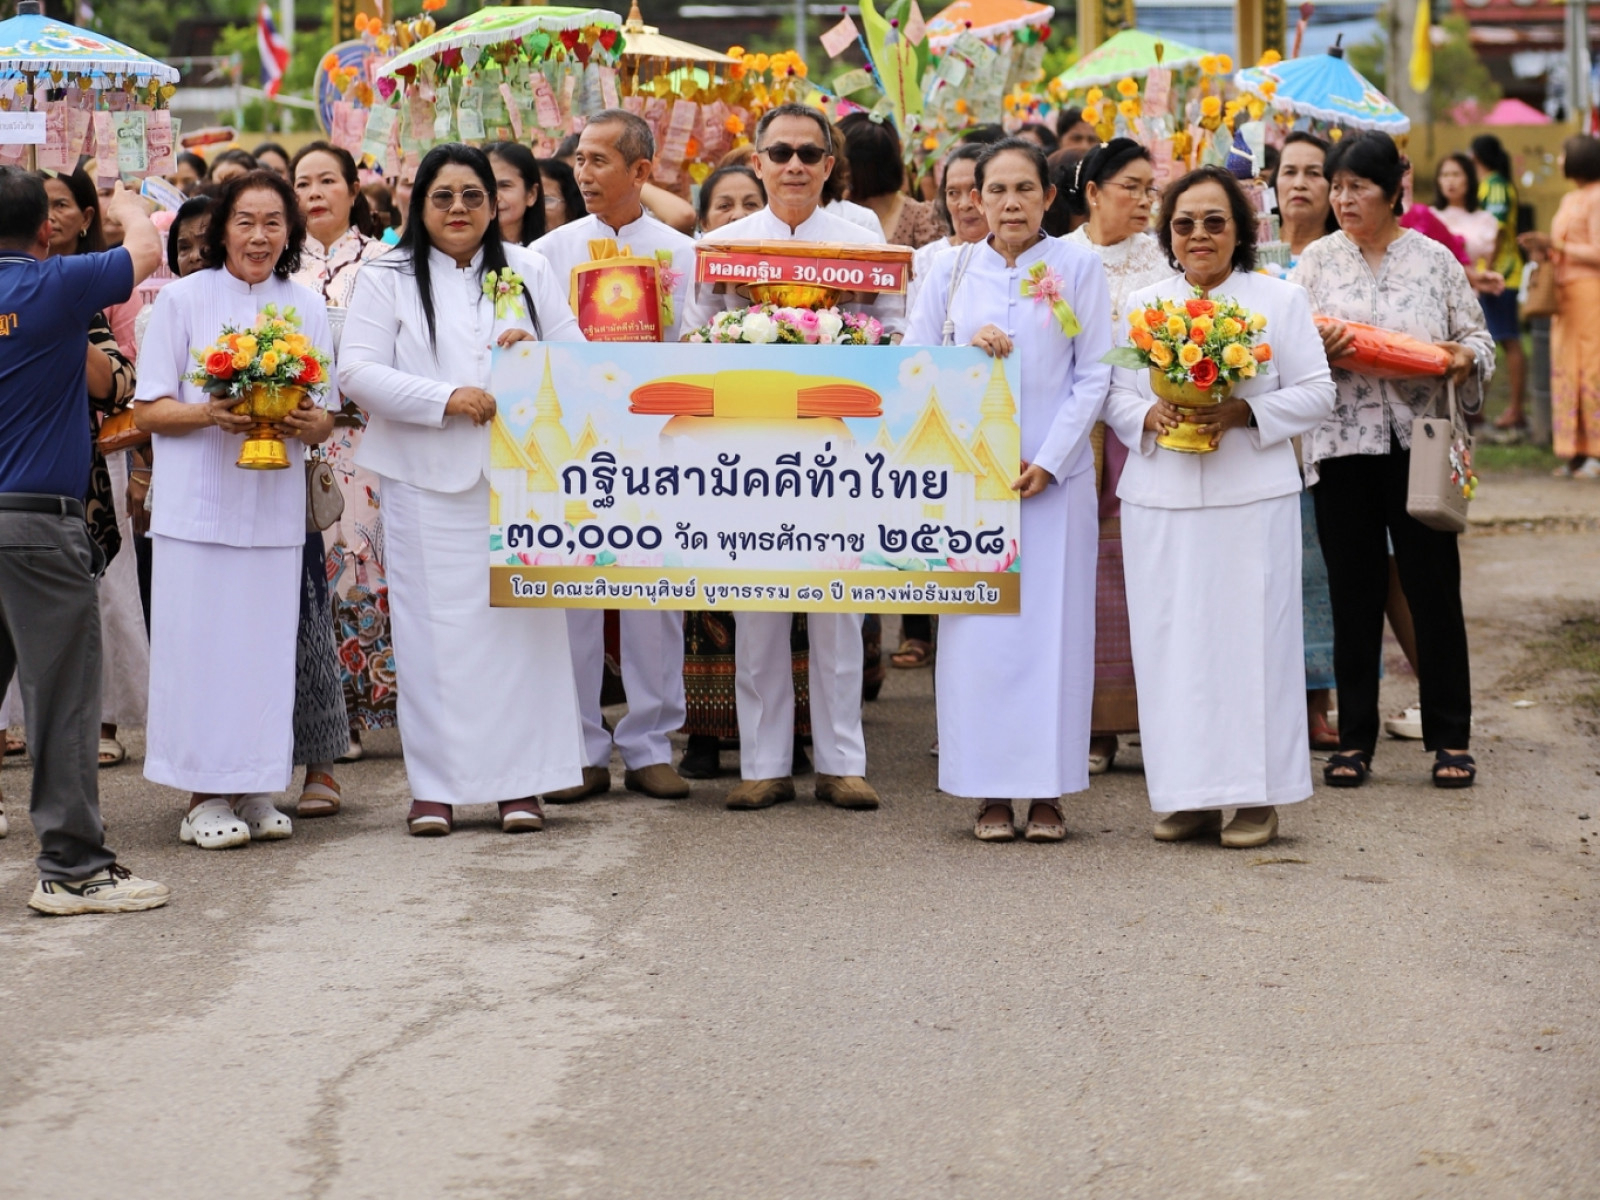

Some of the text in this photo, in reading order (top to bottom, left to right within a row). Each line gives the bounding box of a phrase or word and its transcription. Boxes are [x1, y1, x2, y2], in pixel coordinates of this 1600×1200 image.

[709, 261, 895, 287] ทอดกฐิน 30,000 วัด
[562, 441, 949, 508] กฐินสามัคคีทั่วไทย
[507, 521, 1005, 561] ๓๐,๐๐๐ วัด พุทธศักราช ๒๕๖๘
[511, 577, 998, 604] โดย คณะศิษยานุศิษย์ บูชาธรรม ๘๑ ปี หลวงพ่อธัมมชโย
